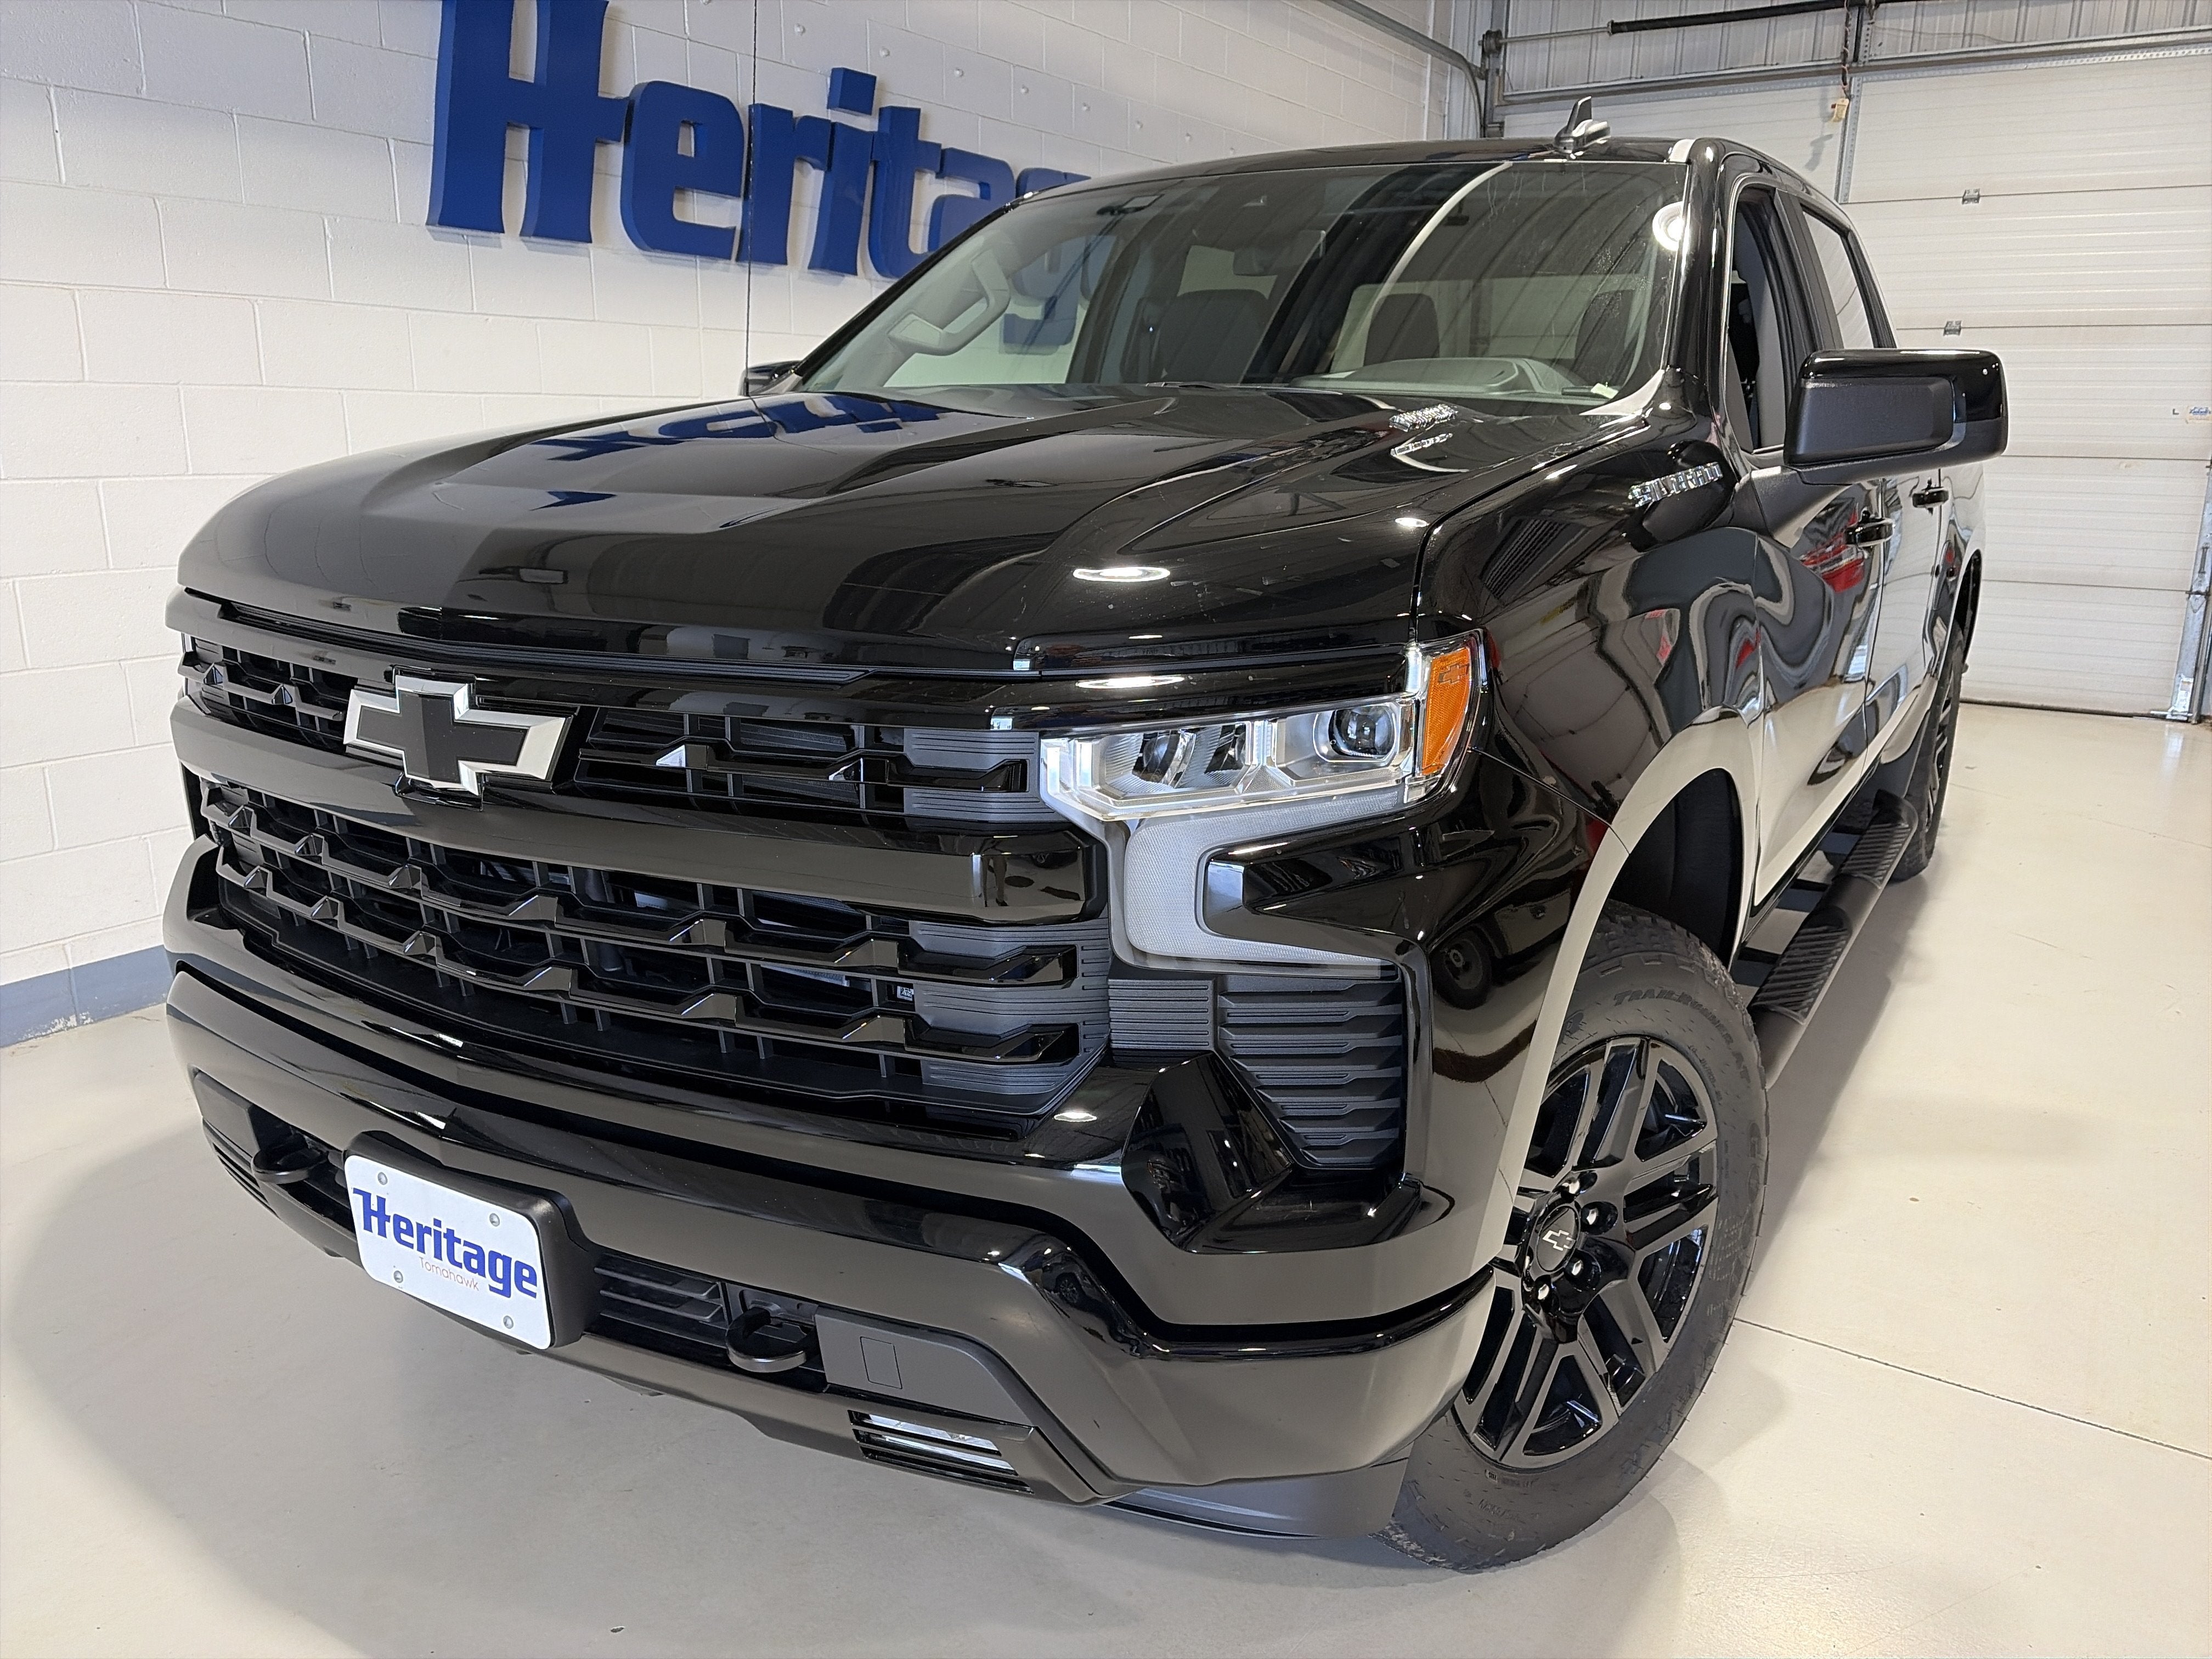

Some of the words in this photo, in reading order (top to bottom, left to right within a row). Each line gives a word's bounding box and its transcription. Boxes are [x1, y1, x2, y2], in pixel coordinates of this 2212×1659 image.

[426, 0, 1092, 347] Heritag
[352, 1187, 538, 1299] Heritage
[419, 1256, 479, 1291] Tomahawk
